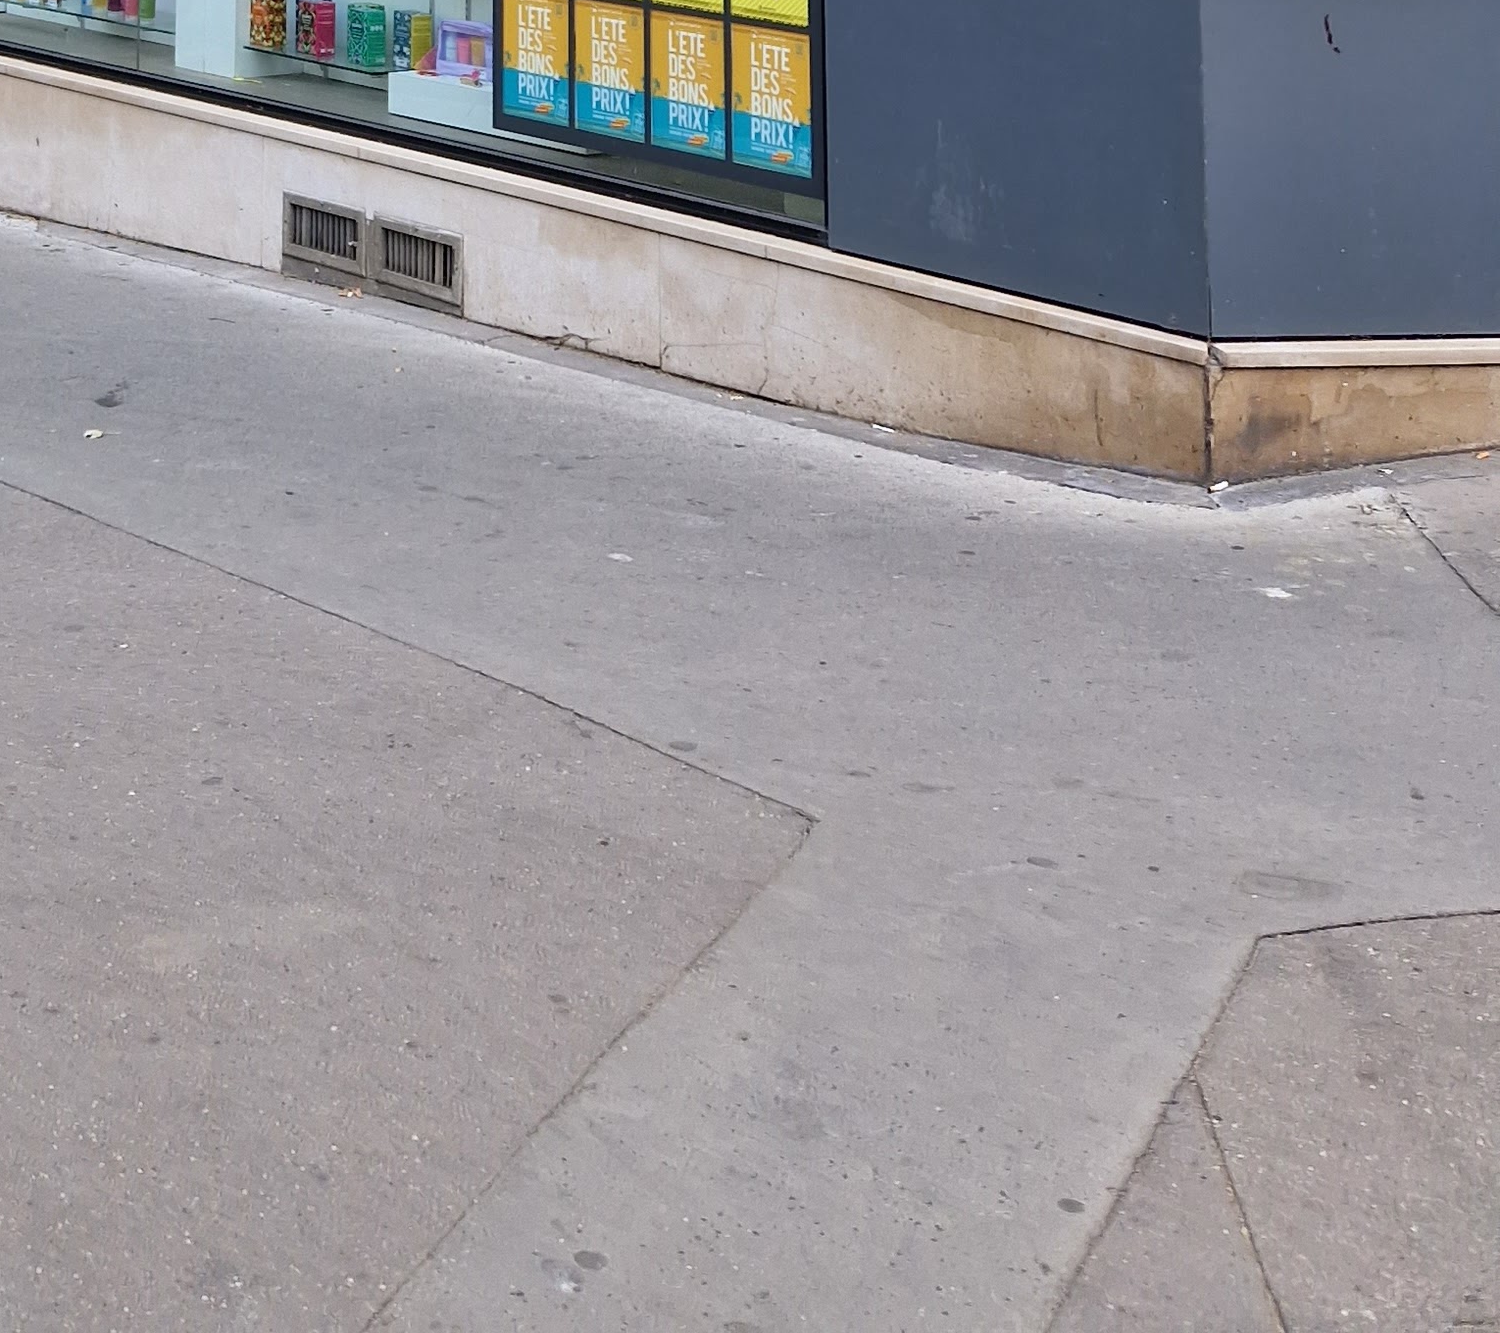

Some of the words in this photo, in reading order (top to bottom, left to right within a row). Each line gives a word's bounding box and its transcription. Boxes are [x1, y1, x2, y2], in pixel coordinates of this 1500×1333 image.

[518, 26, 543, 52] DES
[591, 39, 618, 65] DES
[518, 50, 554, 77] BONS
[591, 63, 629, 90] BONS
[668, 53, 696, 80] DES
[668, 78, 709, 106] BONS
[751, 67, 780, 95] DES
[751, 92, 793, 122] BONS
